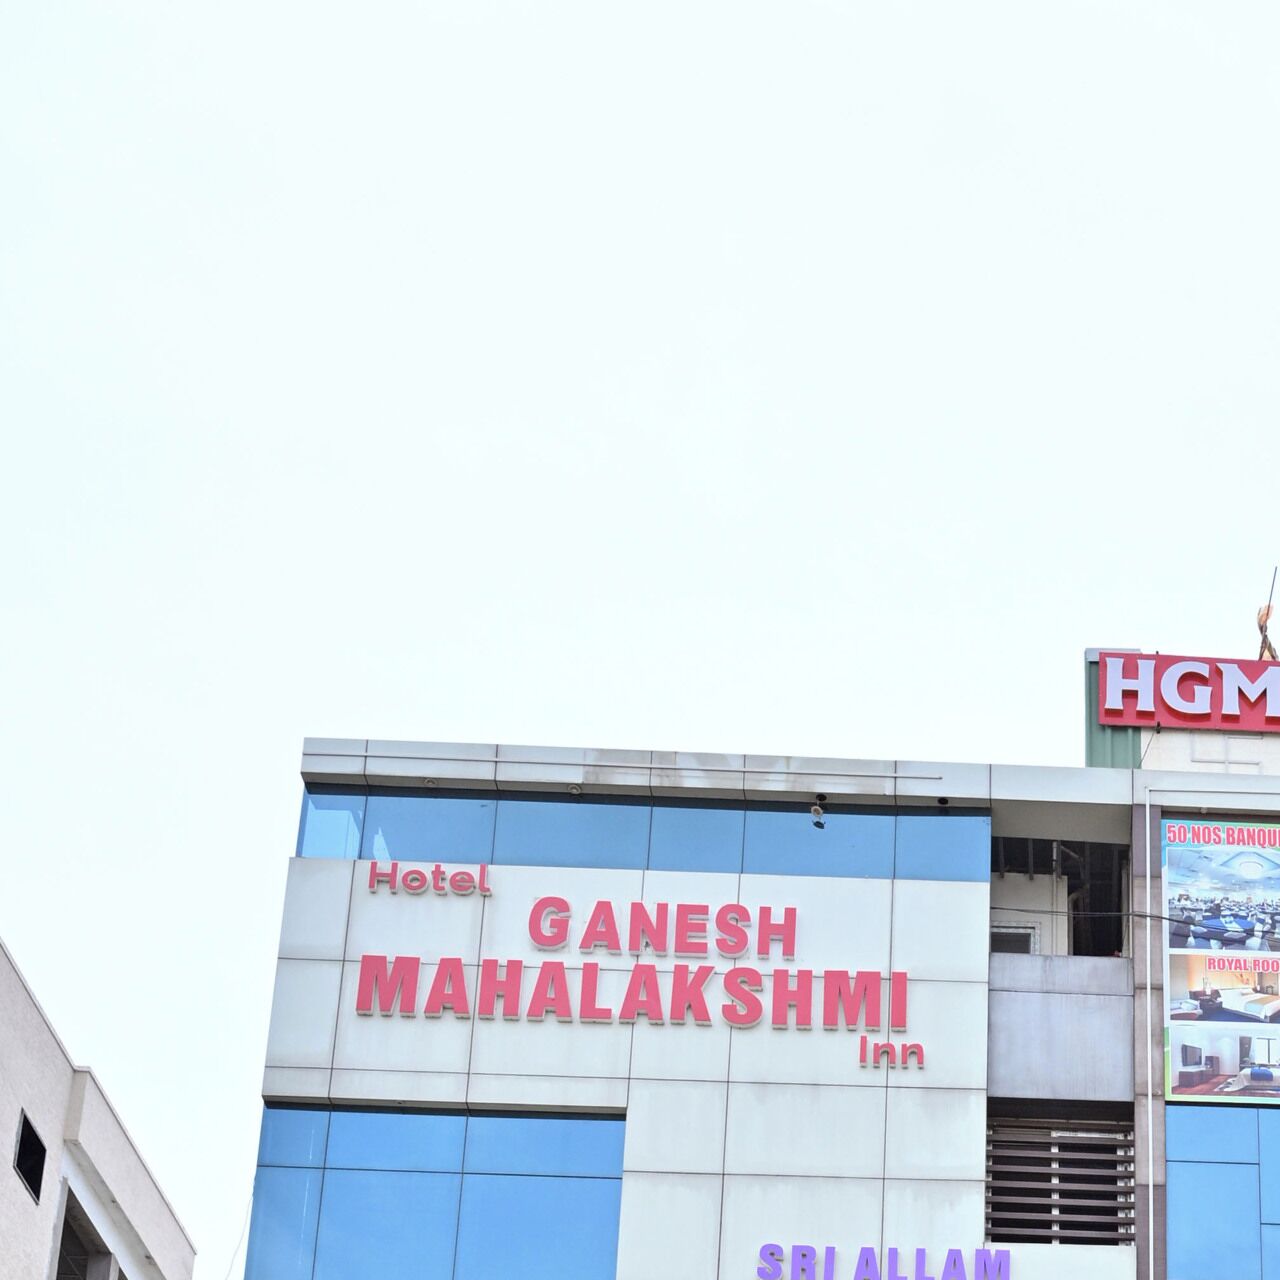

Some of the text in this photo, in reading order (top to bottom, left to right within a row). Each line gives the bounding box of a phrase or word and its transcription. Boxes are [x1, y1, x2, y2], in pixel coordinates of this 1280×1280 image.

[1167, 824, 1187, 843] 50
[1191, 825, 1222, 845] NOS
[368, 861, 492, 896] Hotel
[527, 896, 798, 960] GANESH
[1208, 957, 1249, 971] ROYAL
[356, 954, 909, 1032] MAHALAKSHMI
[859, 1035, 925, 1069] Inn
